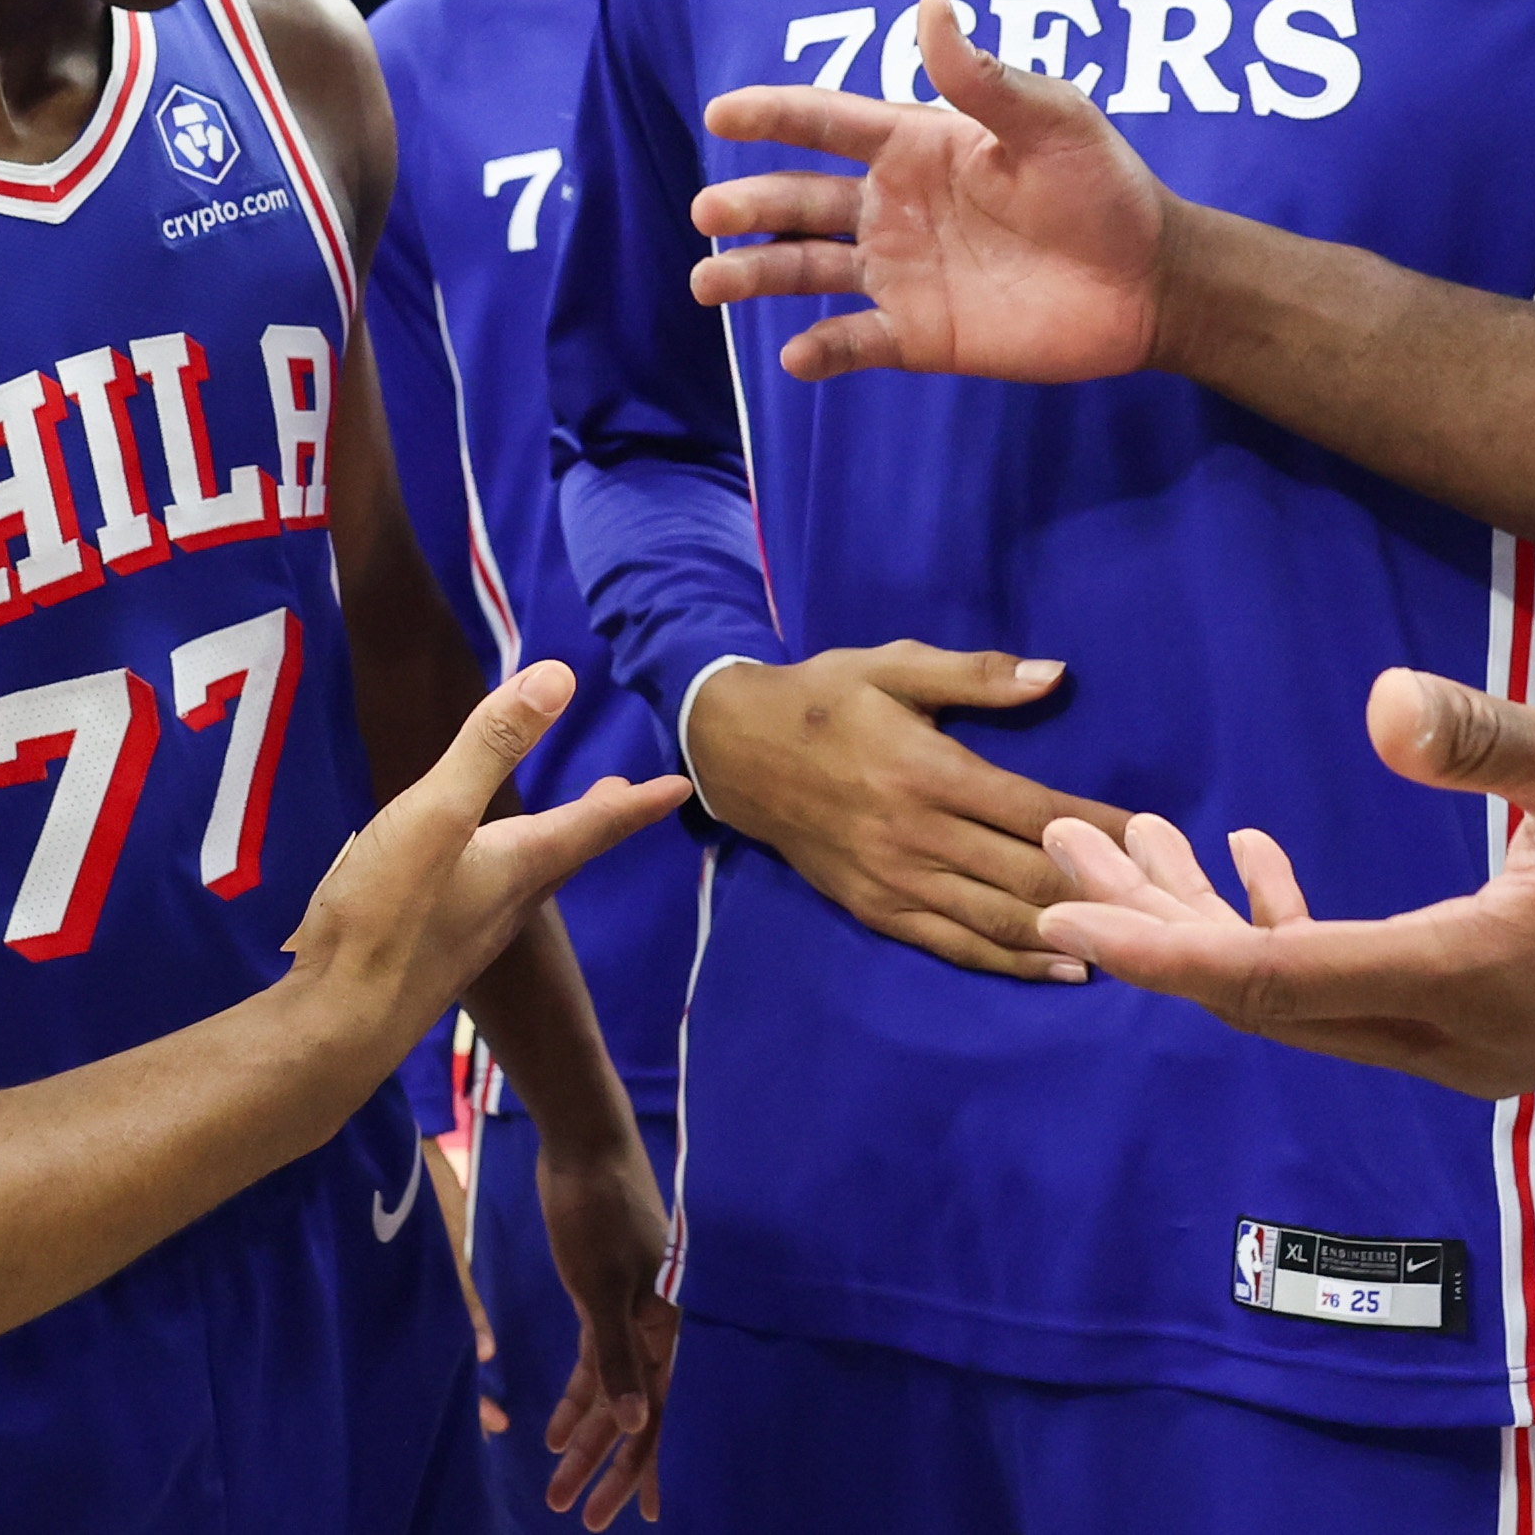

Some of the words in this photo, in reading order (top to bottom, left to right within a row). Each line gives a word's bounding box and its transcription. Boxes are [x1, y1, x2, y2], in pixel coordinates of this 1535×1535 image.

[161, 185, 290, 242] crypto.com
[1284, 1242, 1309, 1263] XL
[1320, 1245, 1398, 1263] ENGINEERED
[1320, 1290, 1340, 1308] 76
[1350, 1289, 1381, 1313] 25
